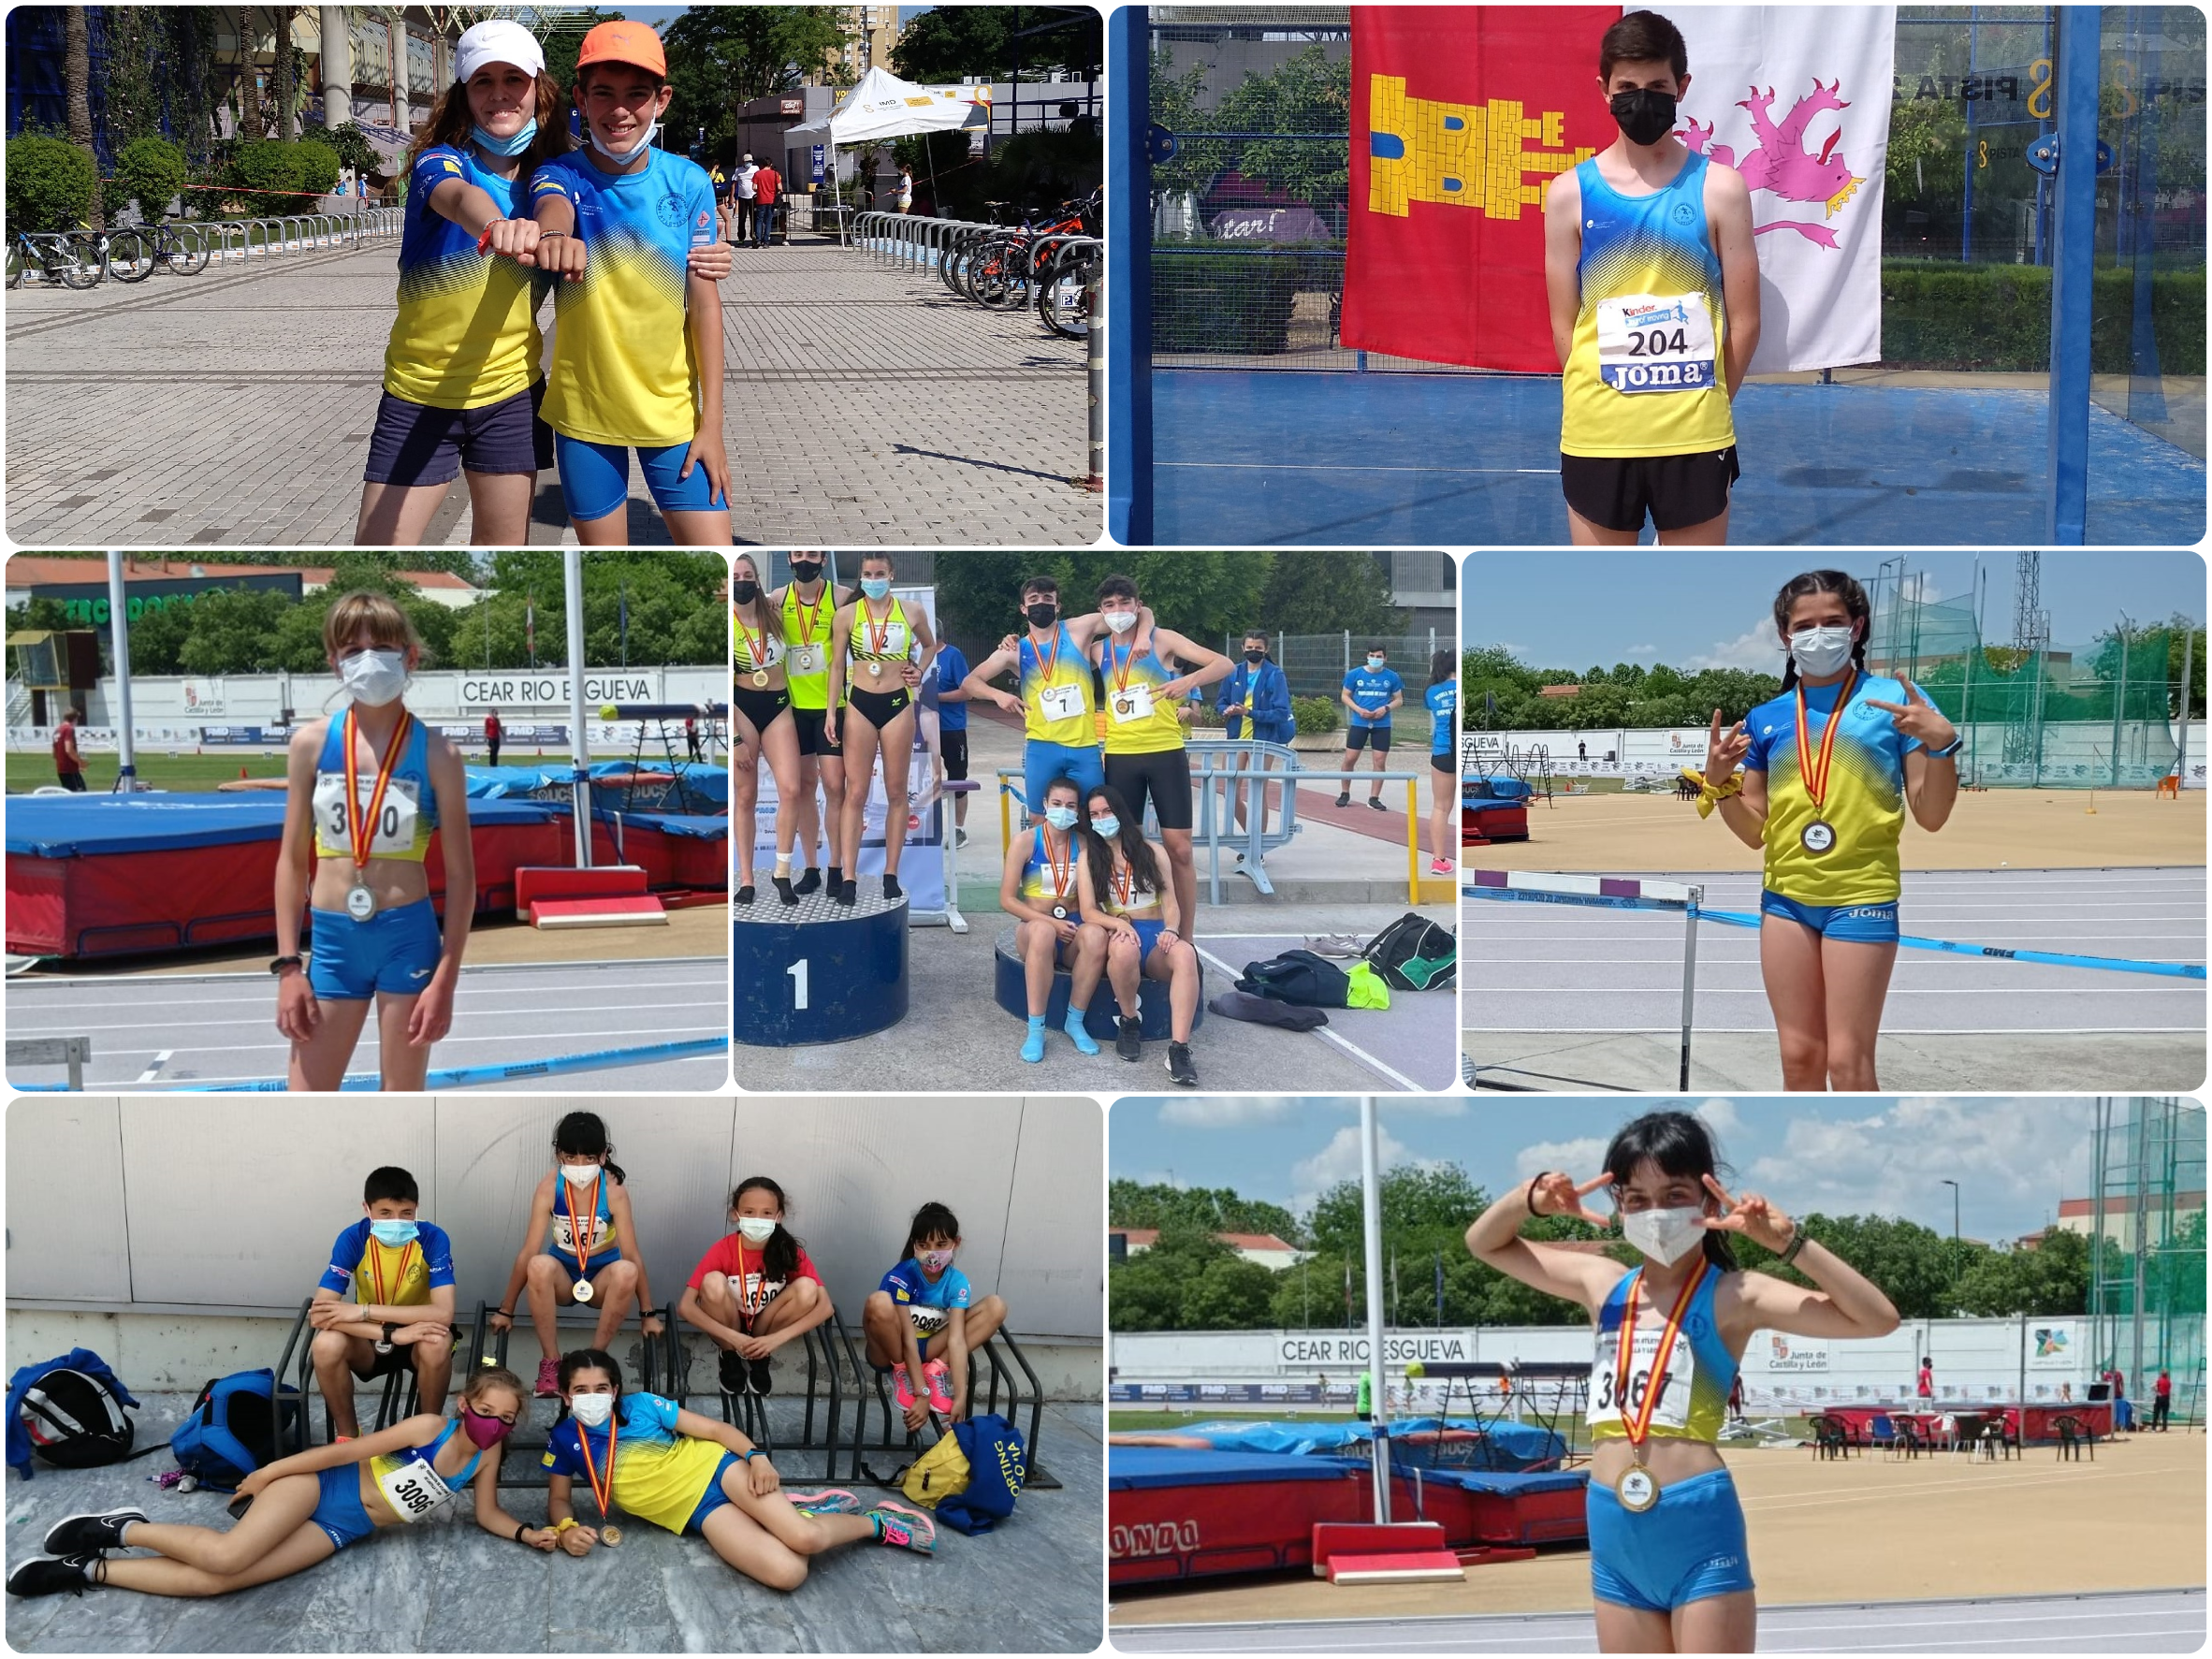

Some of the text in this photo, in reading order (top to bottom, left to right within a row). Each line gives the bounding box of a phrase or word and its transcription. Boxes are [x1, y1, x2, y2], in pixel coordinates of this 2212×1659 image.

[1628, 328, 1688, 357] 204
[881, 634, 888, 648] 2
[766, 648, 774, 662] 2
[463, 679, 651, 702] CEAR RIO EGUEVA
[1059, 699, 1067, 712] 7
[506, 726, 534, 736] FMD
[1130, 891, 1138, 904] 7
[1983, 947, 2016, 958] FMD
[787, 958, 808, 1010] 1
[1283, 1339, 1464, 1361] CEAR RIO ESGUEVA
[1790, 1350, 1826, 1360] Junta de
[1768, 1360, 1797, 1369] Castilla
[1807, 1360, 1826, 1369] León
[1142, 1385, 1167, 1394] FMD
[1201, 1385, 1226, 1394] FMD
[1261, 1385, 1288, 1394] FMD
[394, 1478, 434, 1514] 3096
